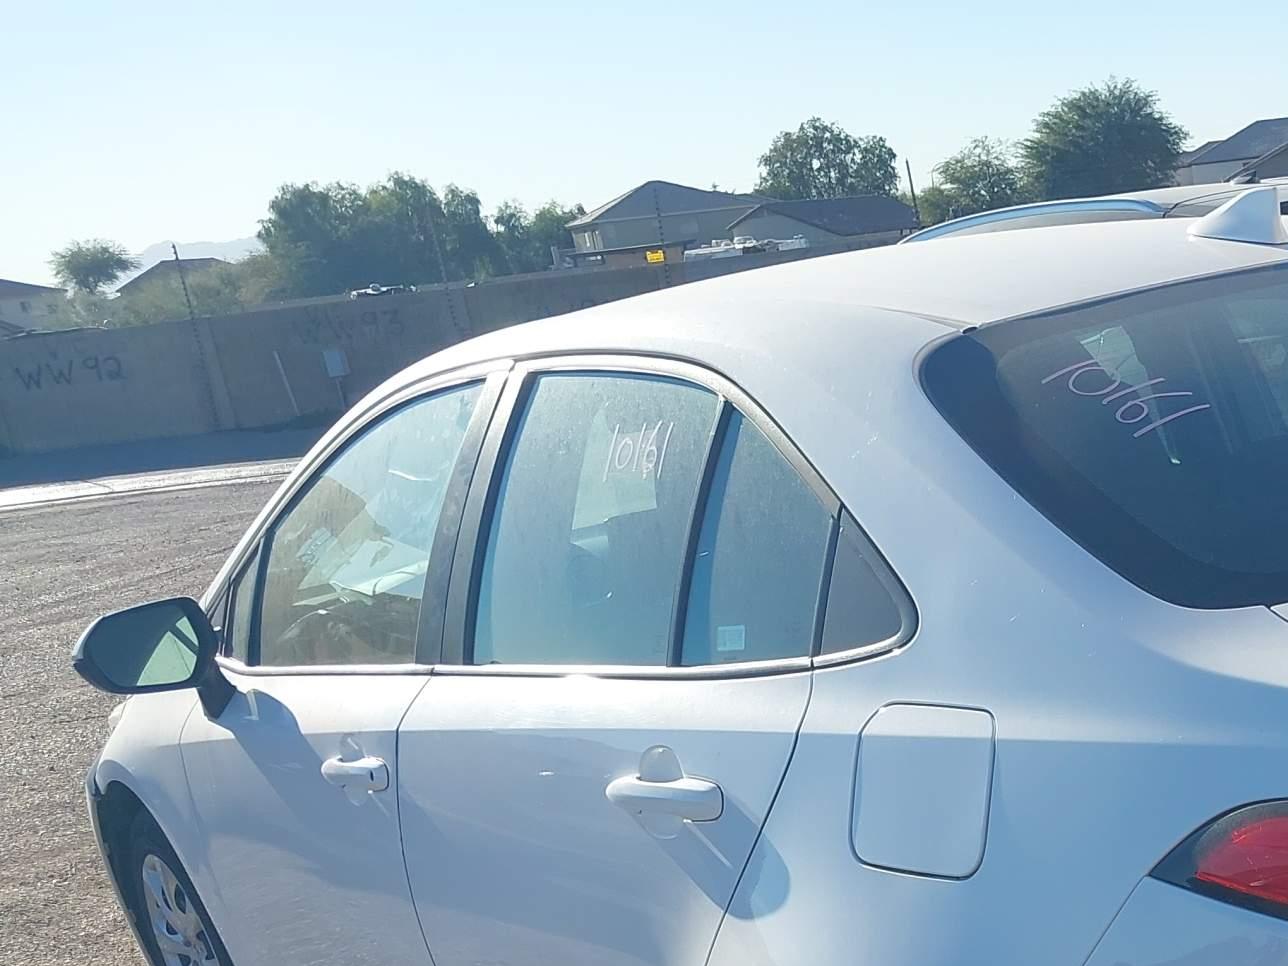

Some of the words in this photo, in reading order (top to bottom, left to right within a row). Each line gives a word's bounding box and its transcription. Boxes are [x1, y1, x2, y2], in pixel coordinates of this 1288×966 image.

[14, 359, 74, 391] WW
[81, 355, 128, 383] 92
[1040, 358, 1212, 439] 10161
[602, 420, 675, 483] 10161
